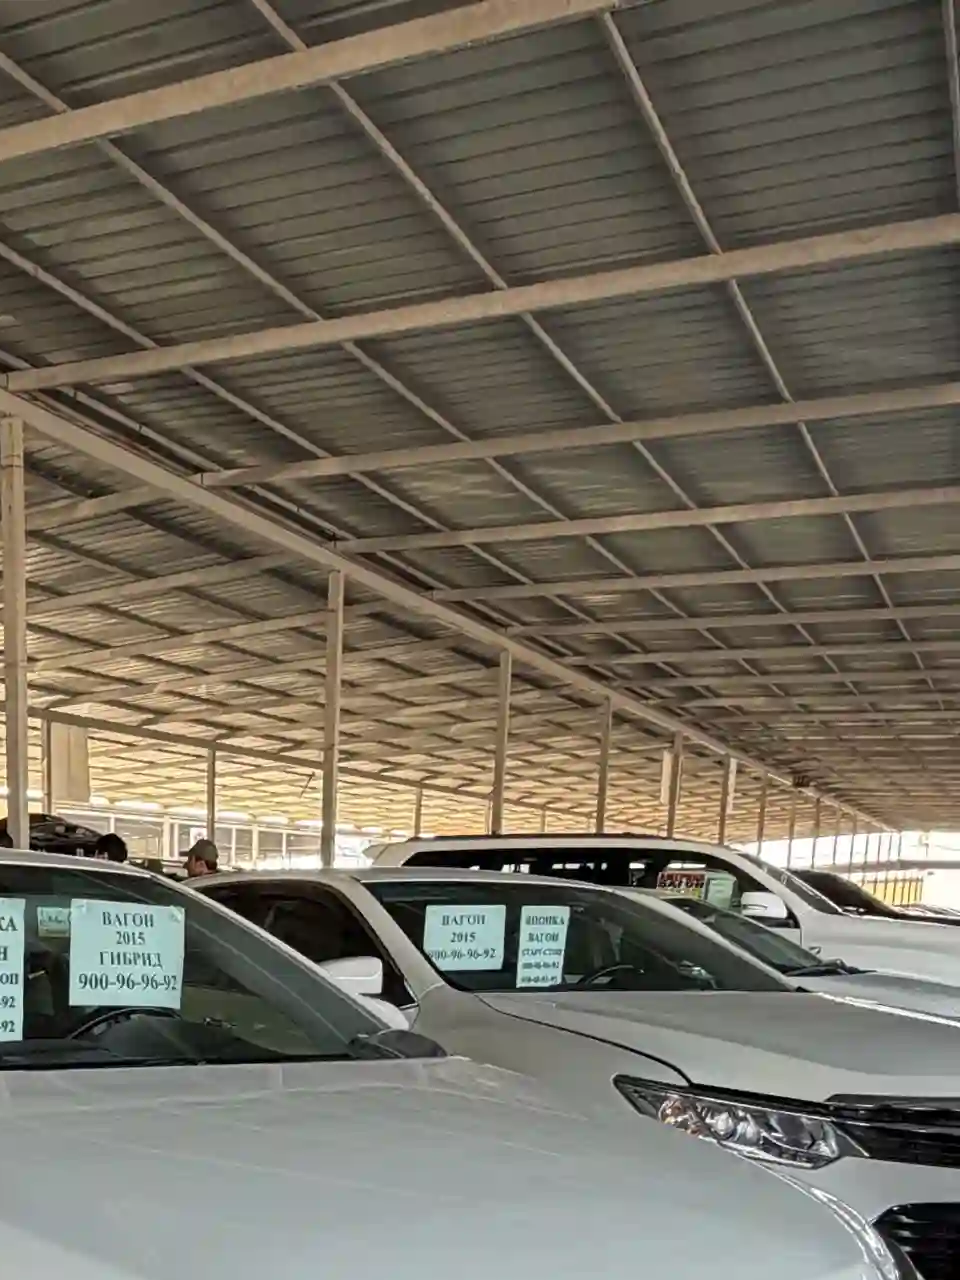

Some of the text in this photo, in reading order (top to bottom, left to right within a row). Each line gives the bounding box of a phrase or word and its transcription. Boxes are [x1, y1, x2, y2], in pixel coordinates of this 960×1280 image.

[101, 911, 155, 928] ВАГОН
[115, 931, 146, 946] 2015
[451, 932, 476, 943] 2015
[99, 951, 164, 969] ГИБРИД
[78, 973, 178, 991] 900-96-96-92
